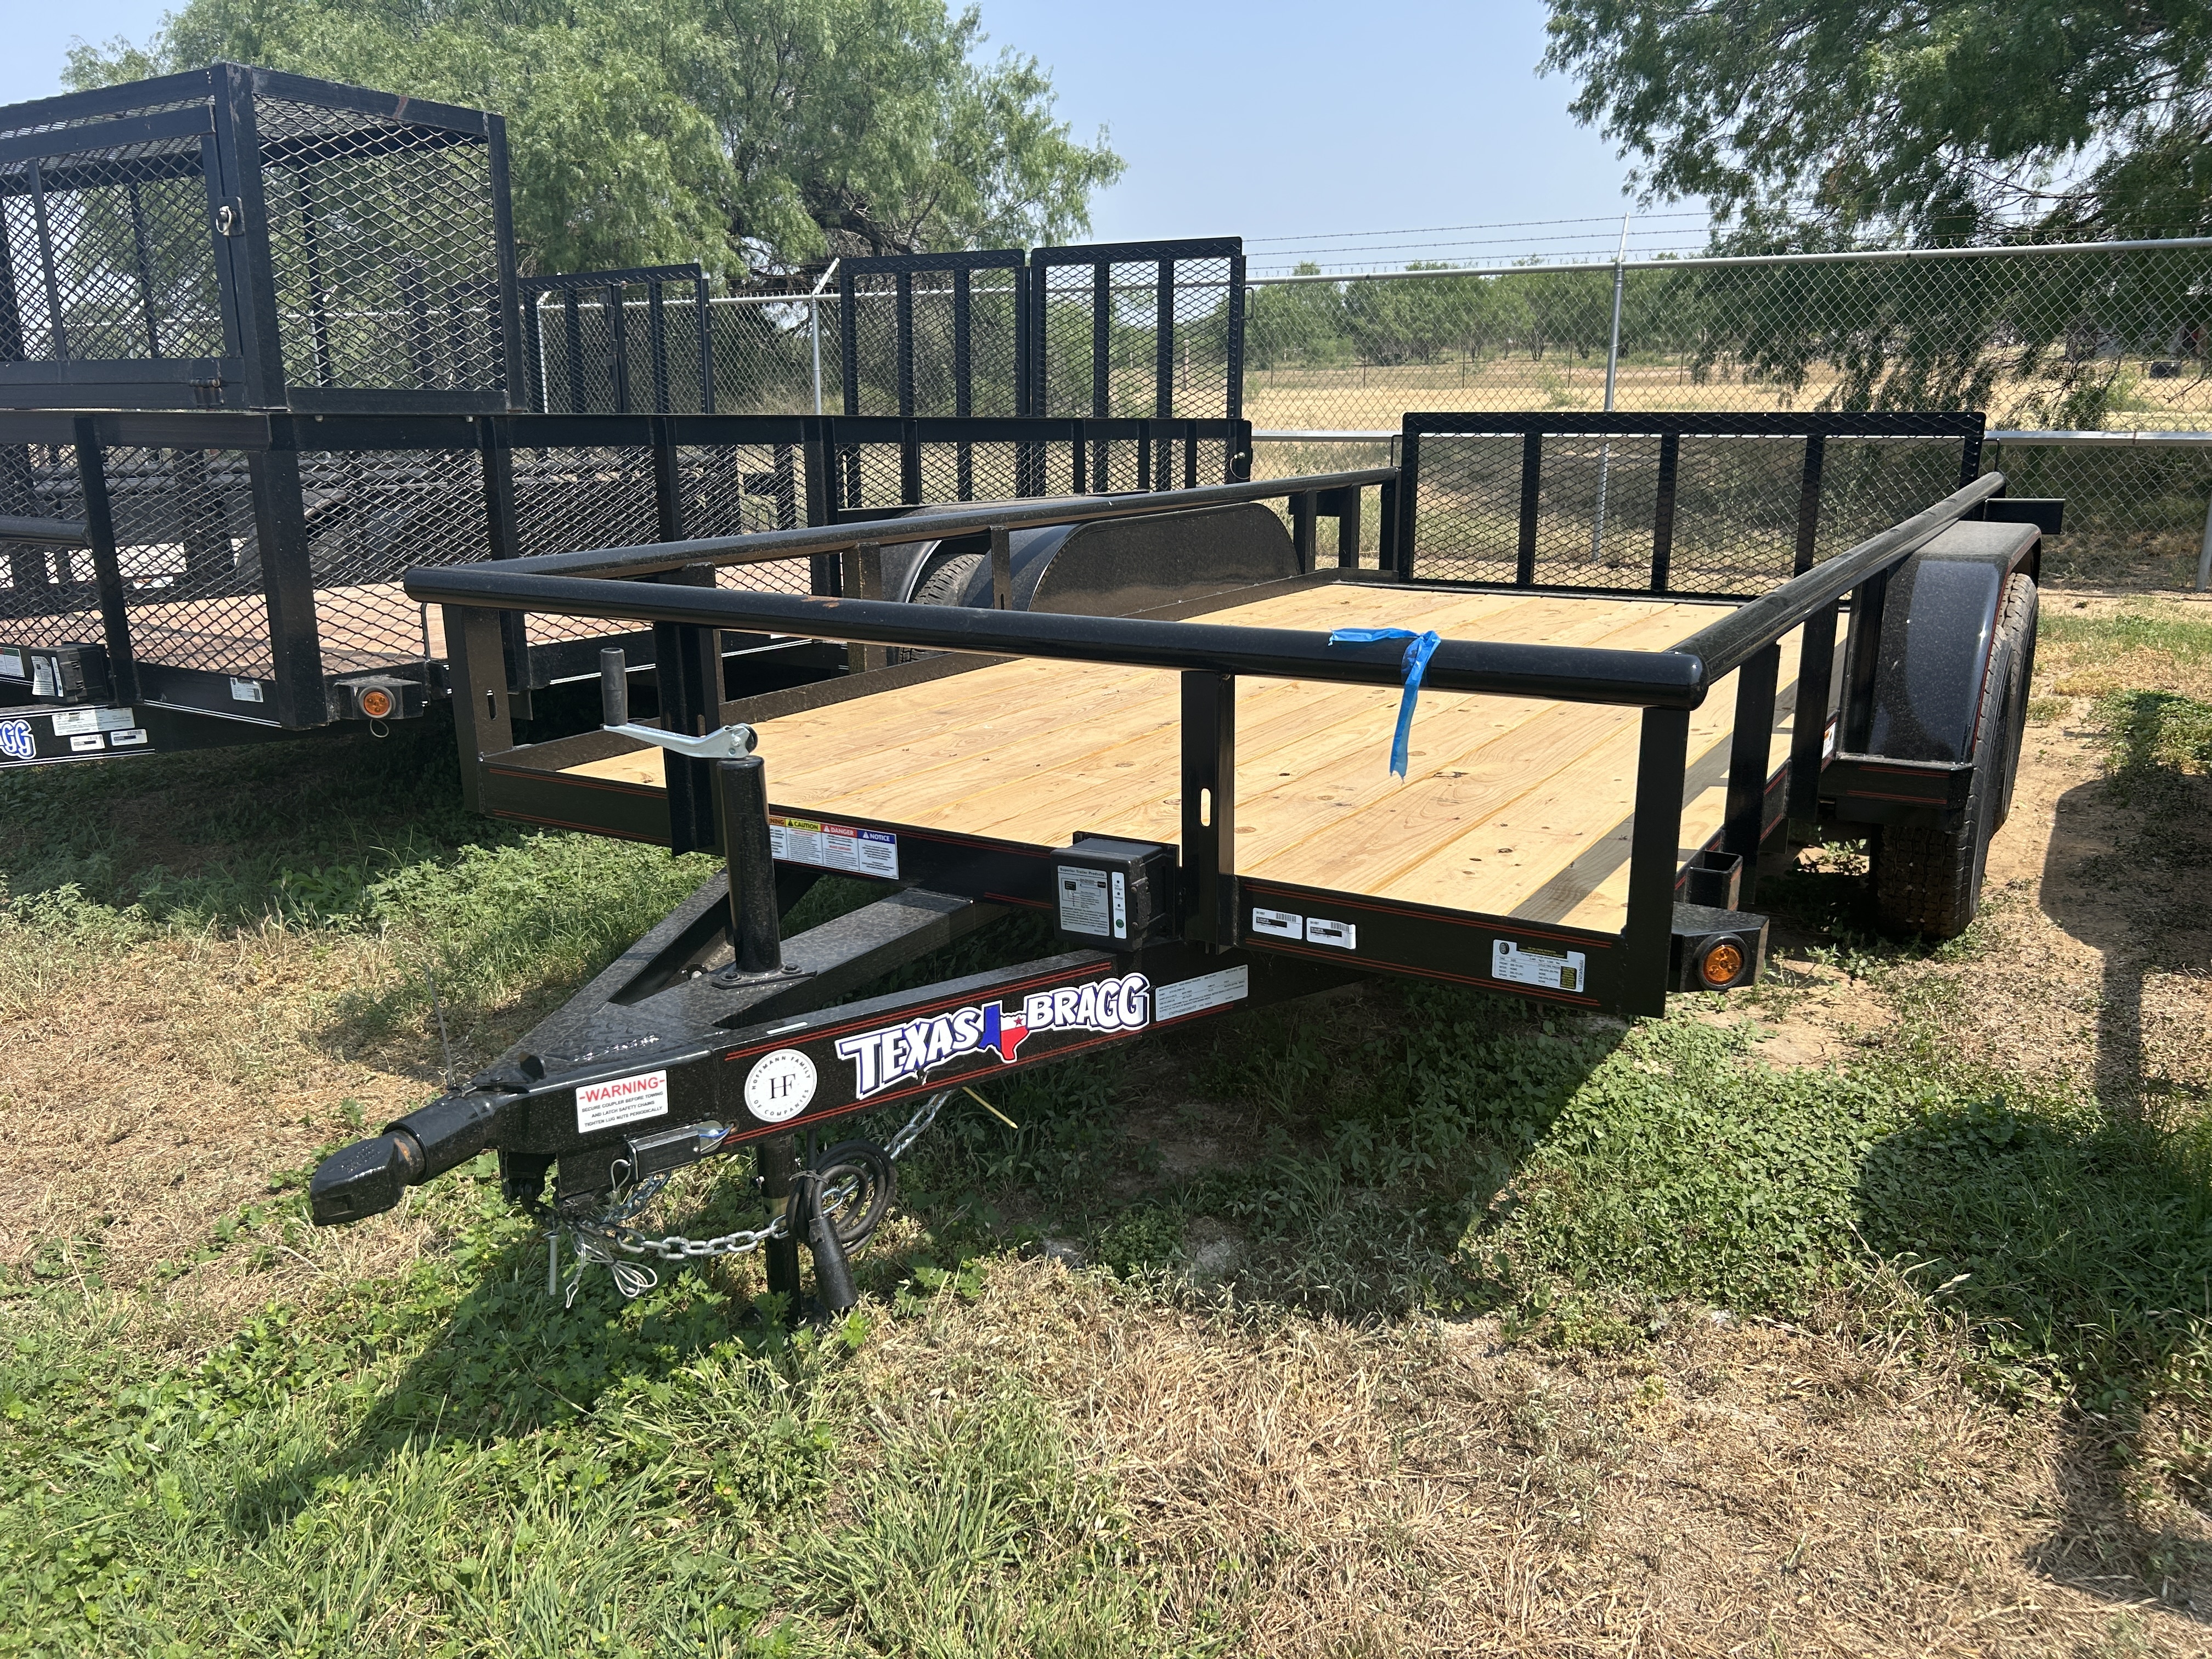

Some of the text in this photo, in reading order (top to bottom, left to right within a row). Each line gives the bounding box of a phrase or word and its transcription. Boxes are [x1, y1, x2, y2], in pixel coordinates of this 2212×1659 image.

[0, 720, 36, 759] GG
[794, 821, 819, 830] CAUTION
[831, 827, 854, 836] DANGER
[870, 833, 890, 842] NOTICE
[835, 1006, 982, 1099] TEXAS
[1026, 972, 1150, 1031] BRAGG
[752, 1056, 811, 1090] HOFFMANN FAMILY
[769, 1074, 796, 1100] HF
[582, 1104, 601, 1113] SECURE
[602, 1099, 624, 1108] COUPLER
[625, 1095, 644, 1103] BEFORE
[630, 1106, 663, 1117] PERIODICALLY
[754, 1090, 809, 1116] OF COMPANIES
